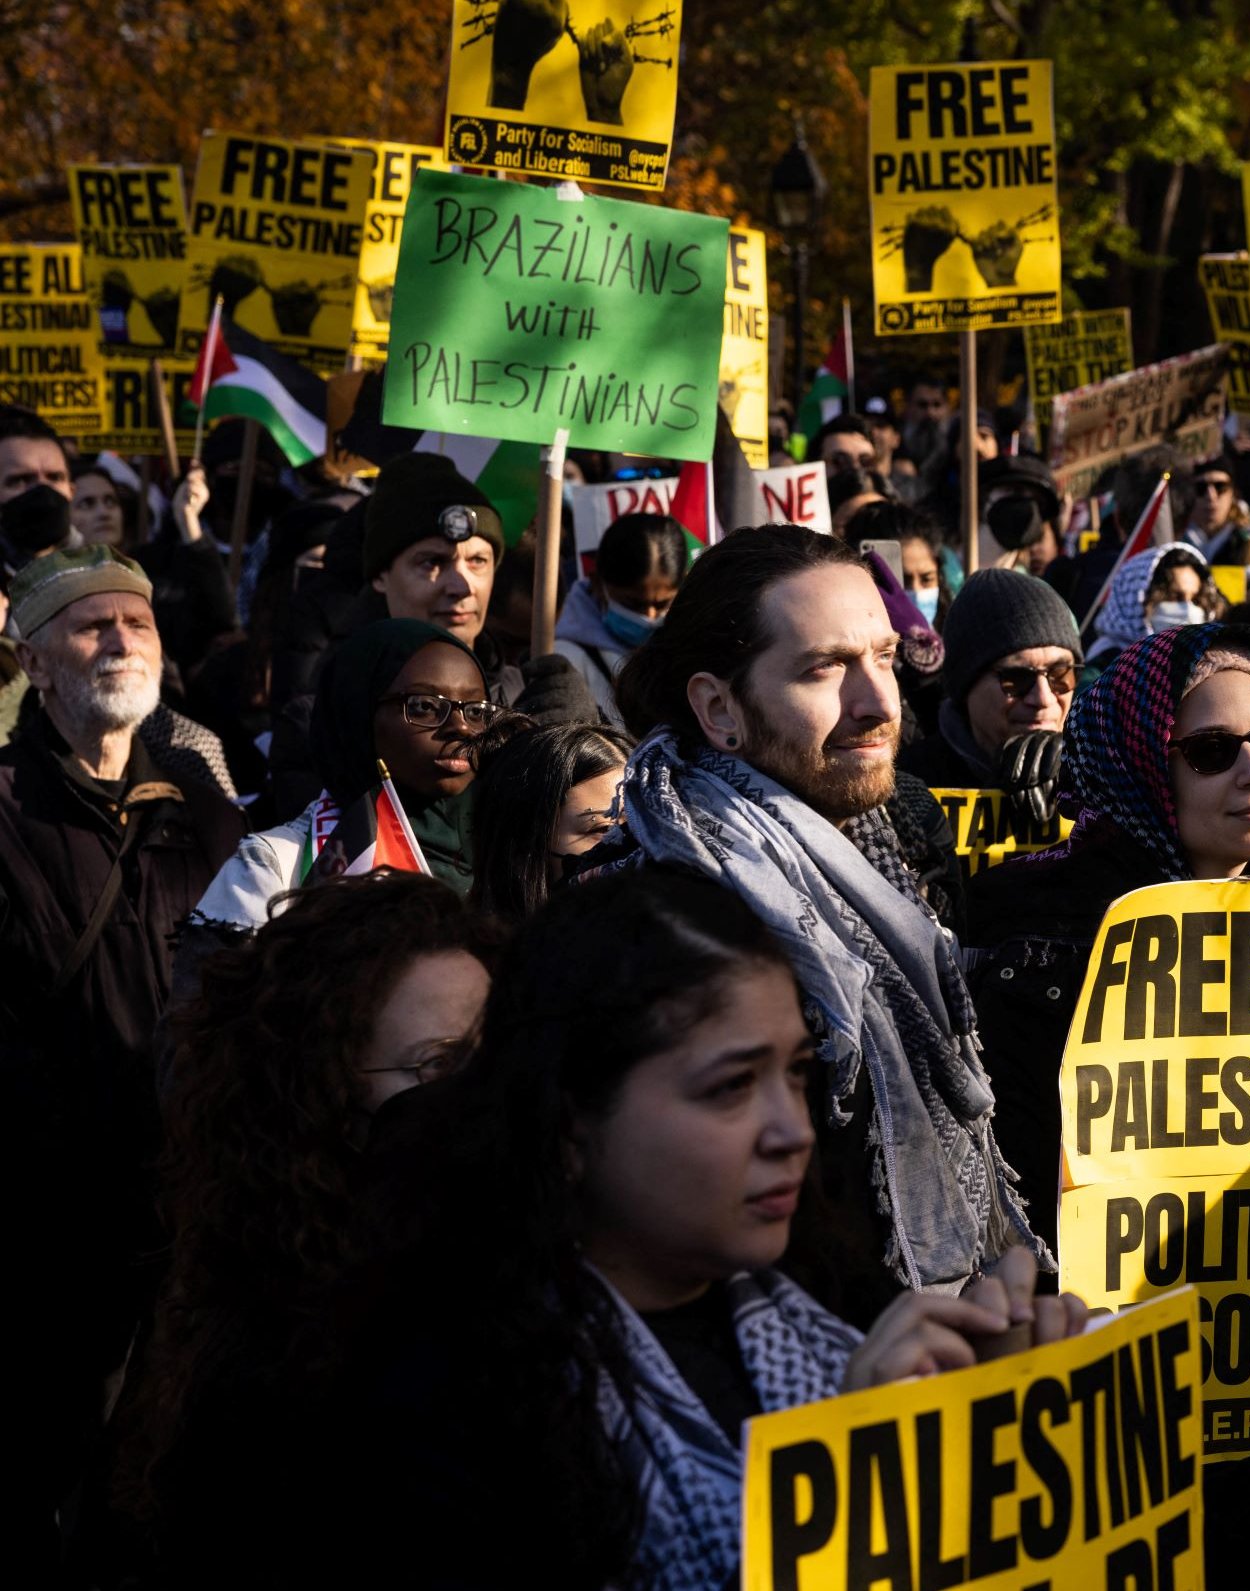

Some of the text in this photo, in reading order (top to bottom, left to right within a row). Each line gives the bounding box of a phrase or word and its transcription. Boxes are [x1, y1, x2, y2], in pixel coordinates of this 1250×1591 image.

[896, 67, 1033, 140] FREE
[494, 150, 520, 168] and
[525, 152, 591, 176] Liberation
[496, 123, 535, 147] Party
[540, 128, 563, 149] for
[567, 132, 622, 157] Socialism
[220, 138, 353, 212] FREE
[874, 144, 1053, 194] PALESTINE
[76, 170, 179, 228] FREE
[83, 229, 187, 261] PALESTINE
[193, 202, 365, 259] PALESTINE
[770, 1320, 1196, 1591] PALESTINE
